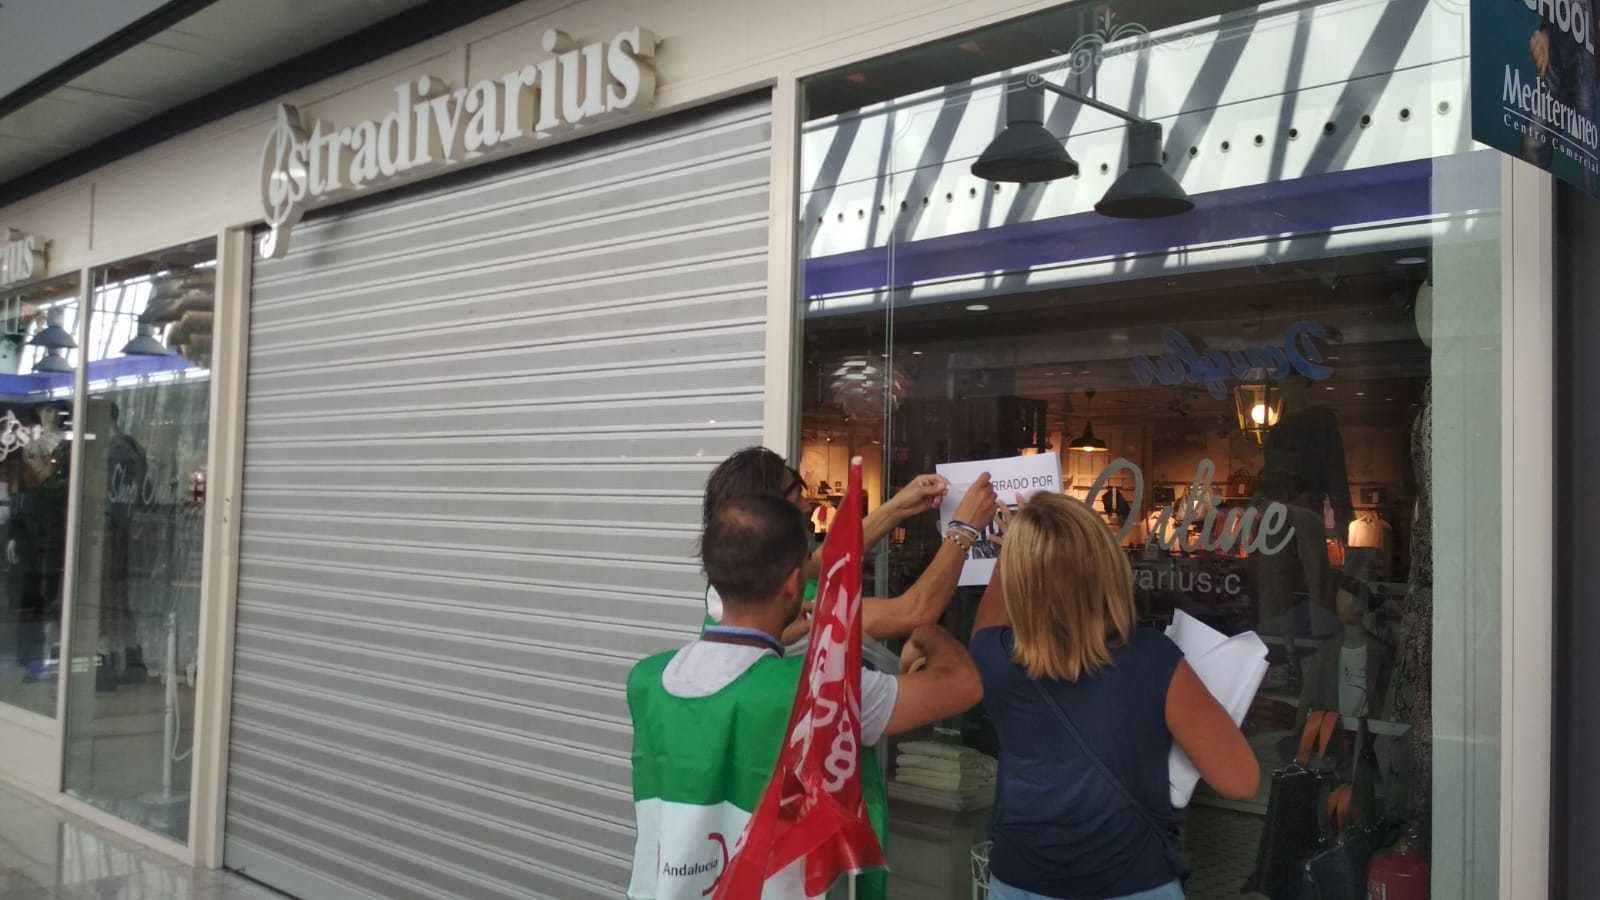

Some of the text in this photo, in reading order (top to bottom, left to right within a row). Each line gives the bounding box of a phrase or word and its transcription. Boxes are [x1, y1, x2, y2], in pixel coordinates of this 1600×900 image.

[1524, 0, 1595, 55] HOOL
[1503, 112, 1599, 176] Centro Comercial
[1032, 474, 1054, 488] POR
